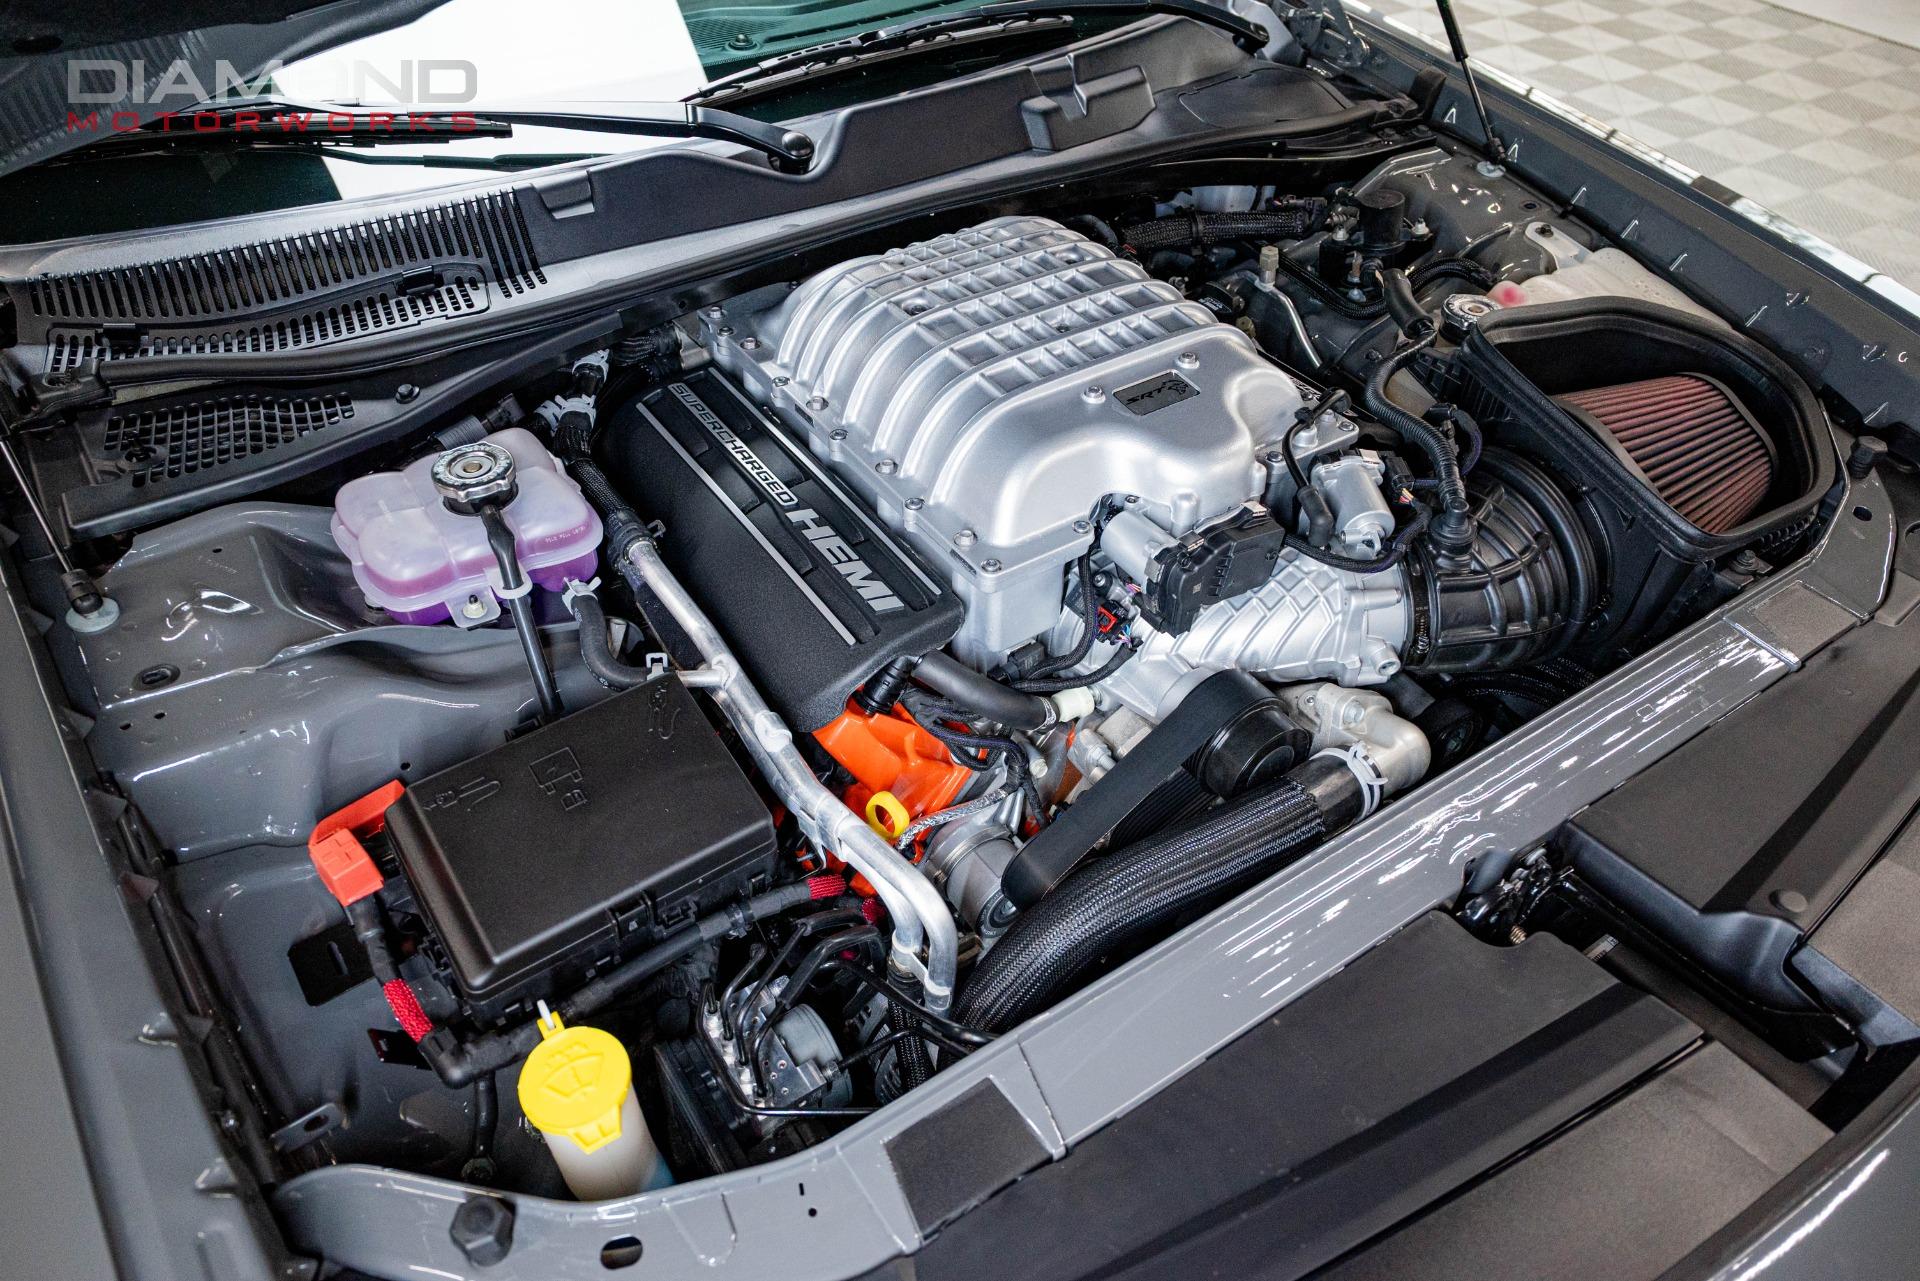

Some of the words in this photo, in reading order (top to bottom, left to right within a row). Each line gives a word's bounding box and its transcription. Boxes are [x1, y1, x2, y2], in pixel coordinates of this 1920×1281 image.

[1126, 386, 1165, 405] SRT
[672, 384, 794, 504] SUPERCHARGED
[785, 508, 905, 613] HEMI
